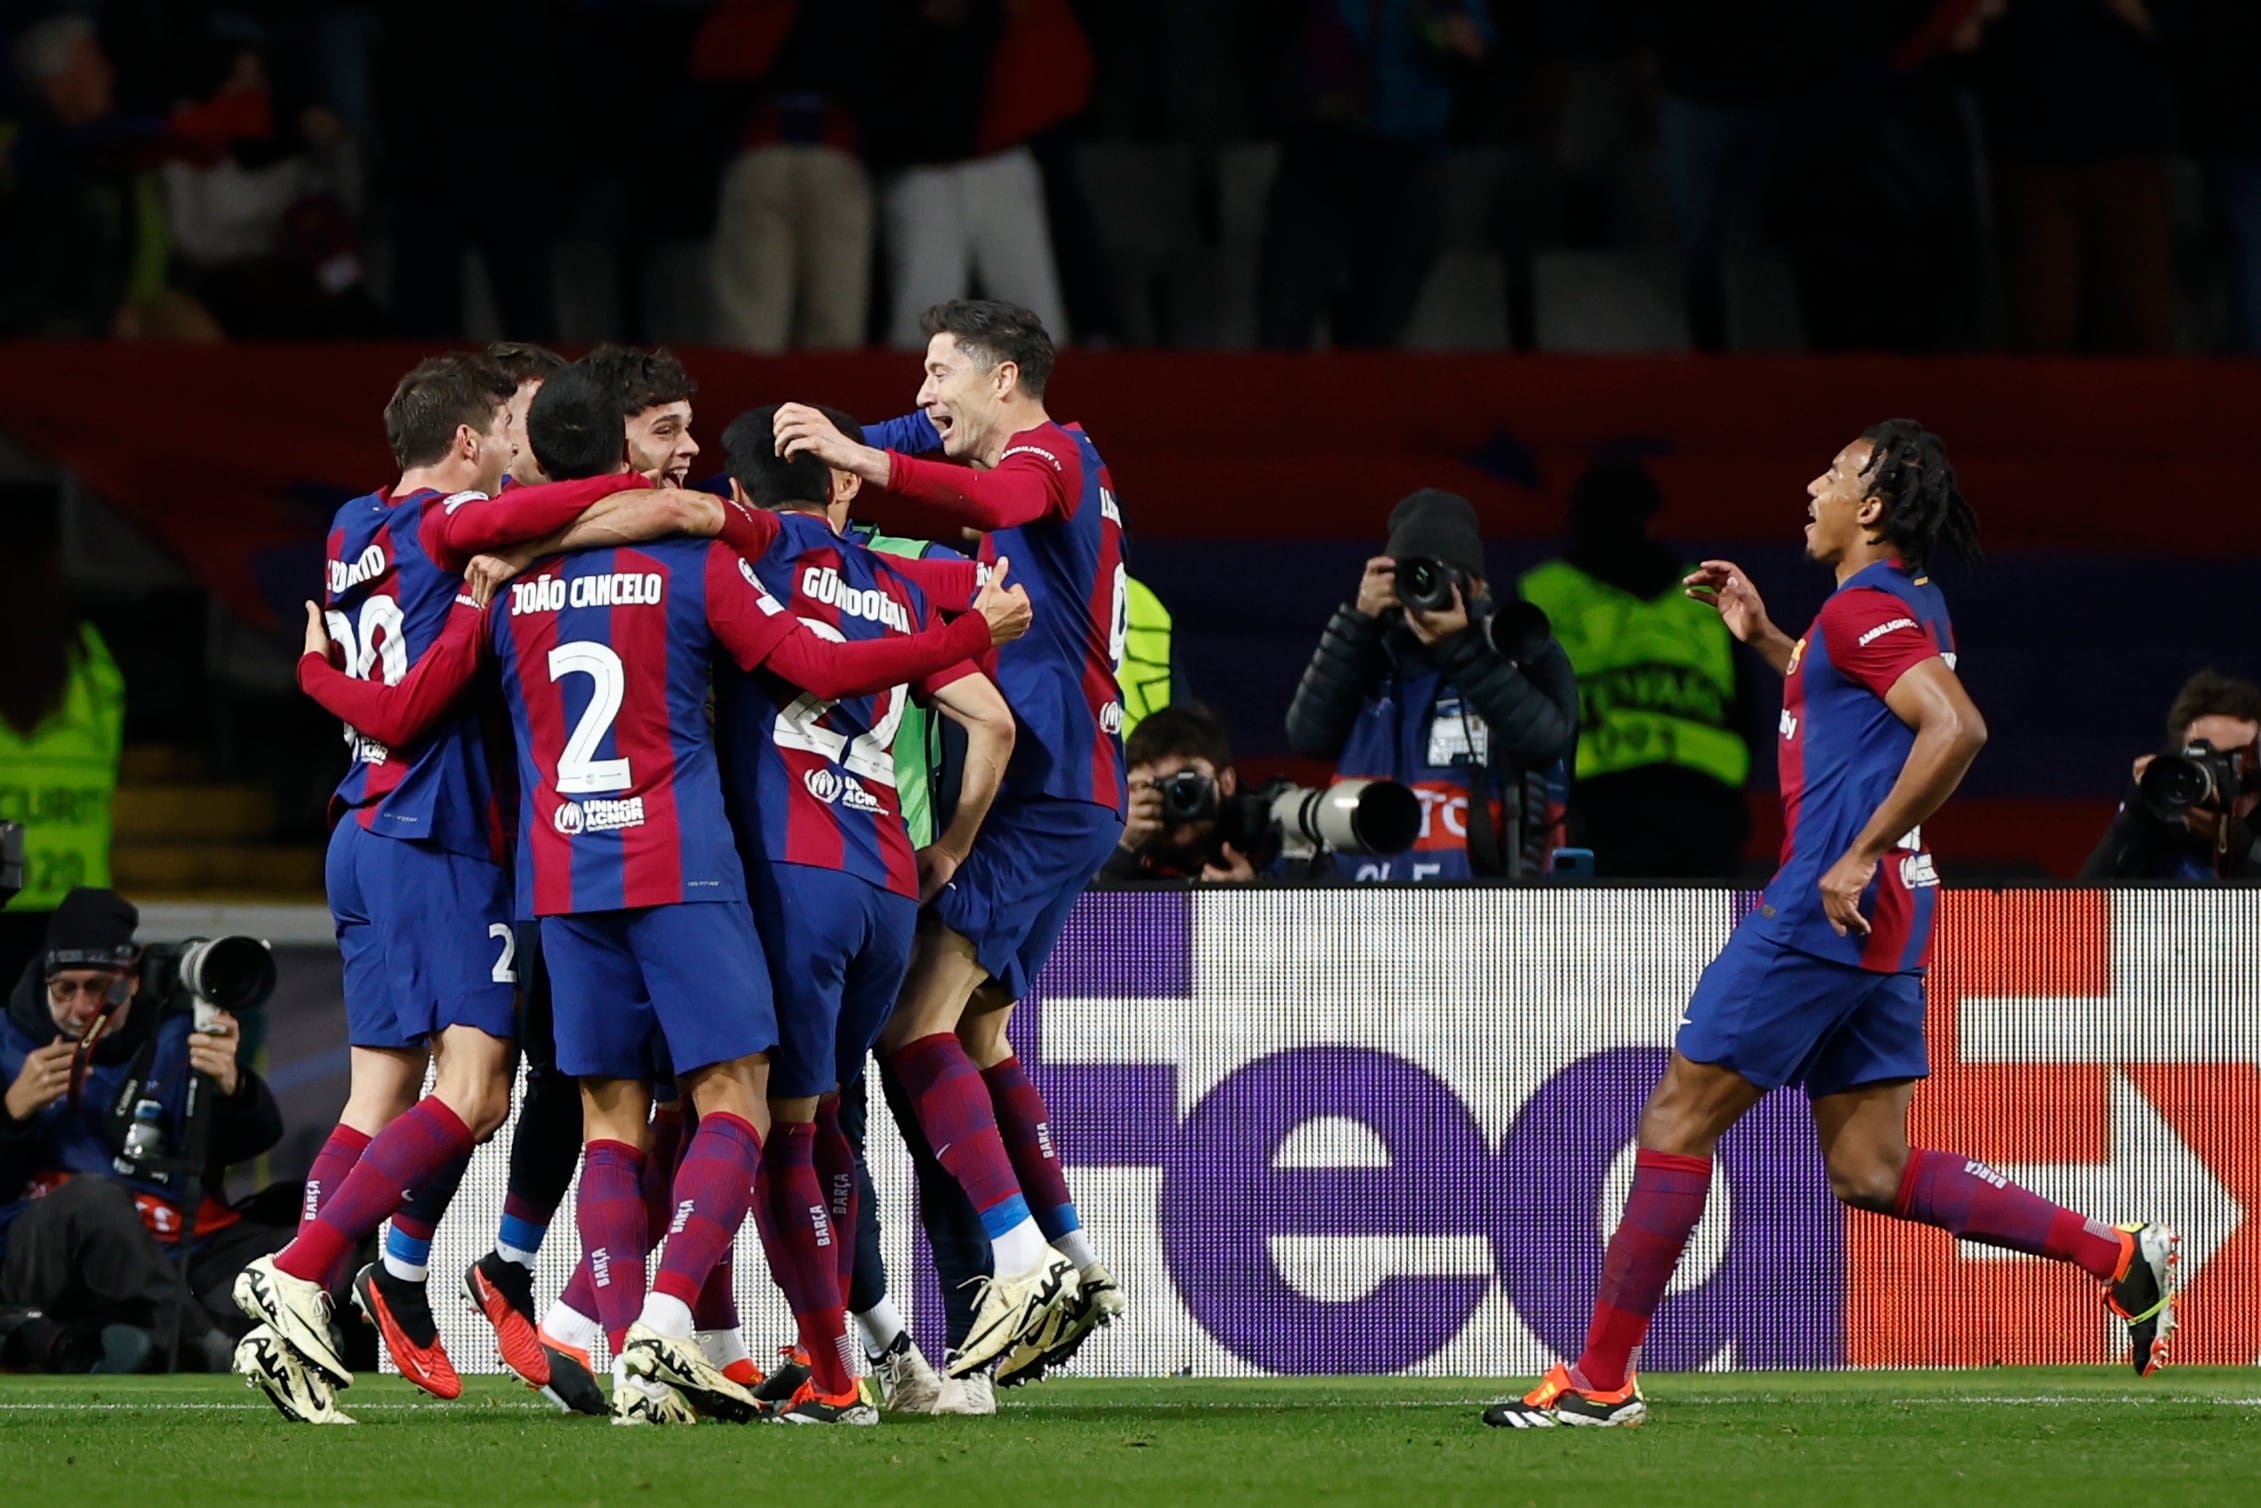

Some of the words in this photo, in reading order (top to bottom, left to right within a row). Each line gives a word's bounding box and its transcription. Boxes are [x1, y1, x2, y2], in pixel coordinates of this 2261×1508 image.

[511, 574, 567, 616] JOÃO
[569, 573, 662, 608] CANCELO
[547, 640, 632, 793] 2
[582, 796, 643, 815] UNHCR
[584, 808, 645, 828] ACNUR
[488, 922, 517, 983] 2
[304, 1179, 321, 1222] BARÇA
[670, 1199, 695, 1235] BARÇA
[809, 1204, 832, 1248] BARÇA
[591, 1247, 612, 1289] BARÇA
